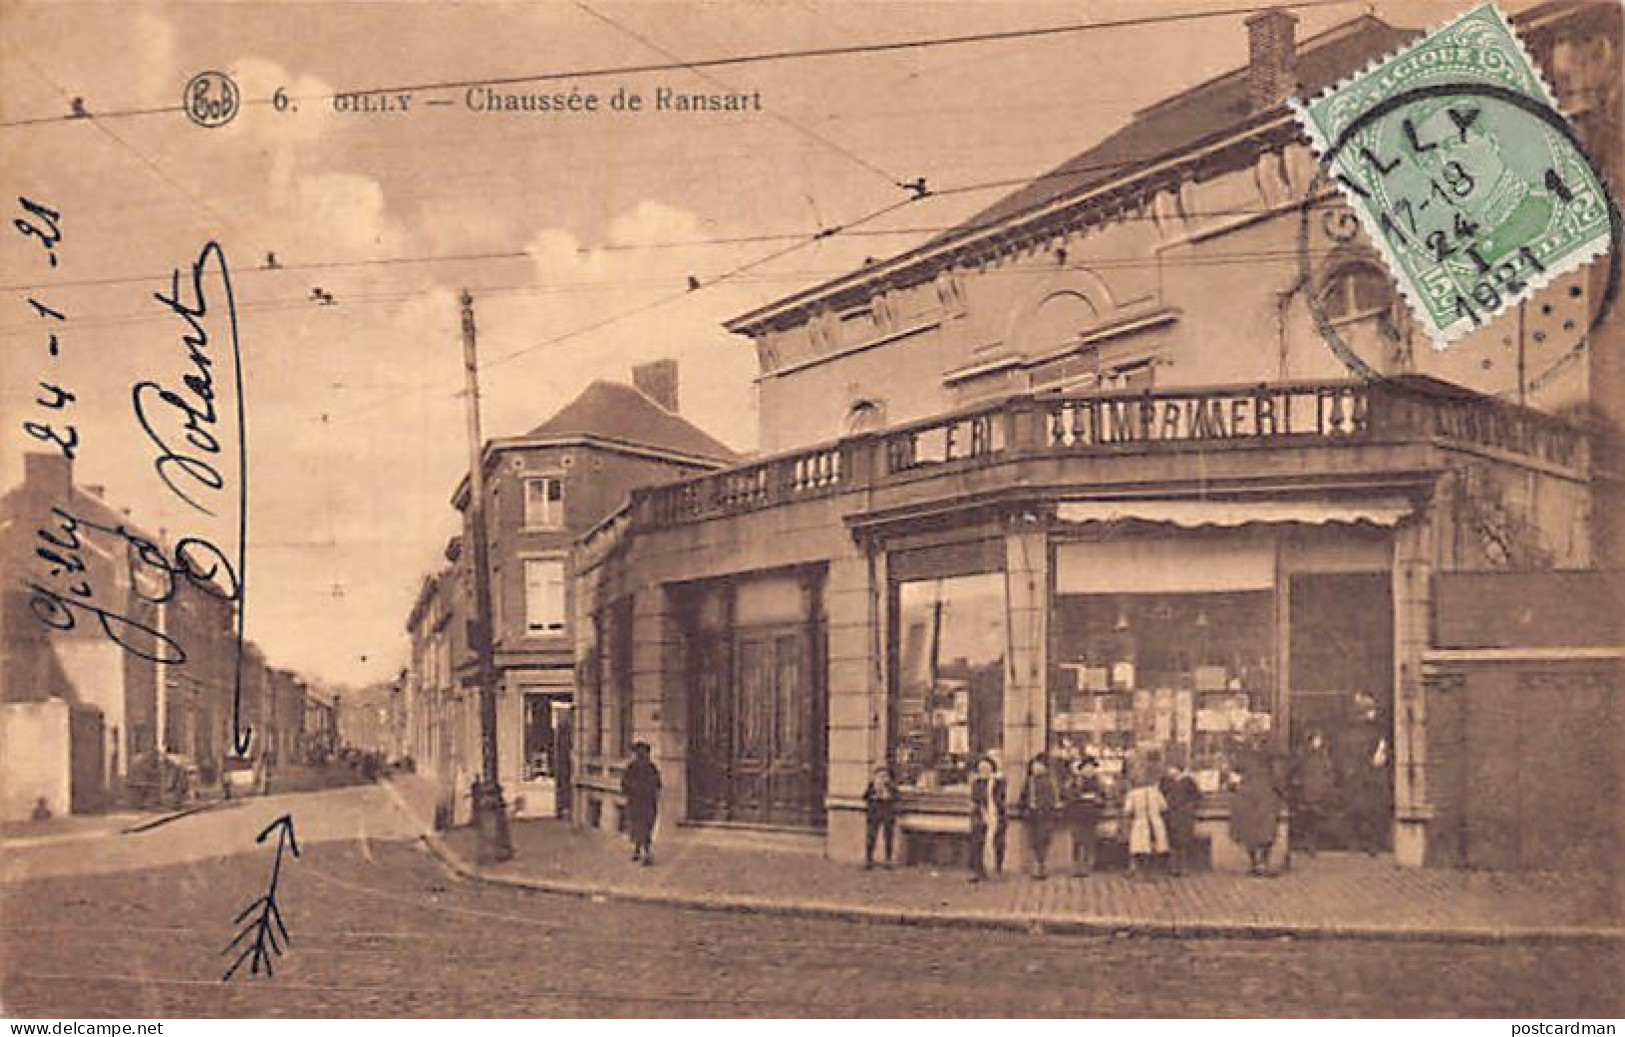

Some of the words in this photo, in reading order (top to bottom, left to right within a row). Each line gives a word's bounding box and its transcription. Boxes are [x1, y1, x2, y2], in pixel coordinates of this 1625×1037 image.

[272, 86, 298, 113] 6.
[333, 94, 412, 113] GILLY
[465, 86, 600, 113] Chaussée
[610, 86, 643, 112] de
[655, 86, 763, 112] Ransart
[1455, 246, 1547, 326] 1921
